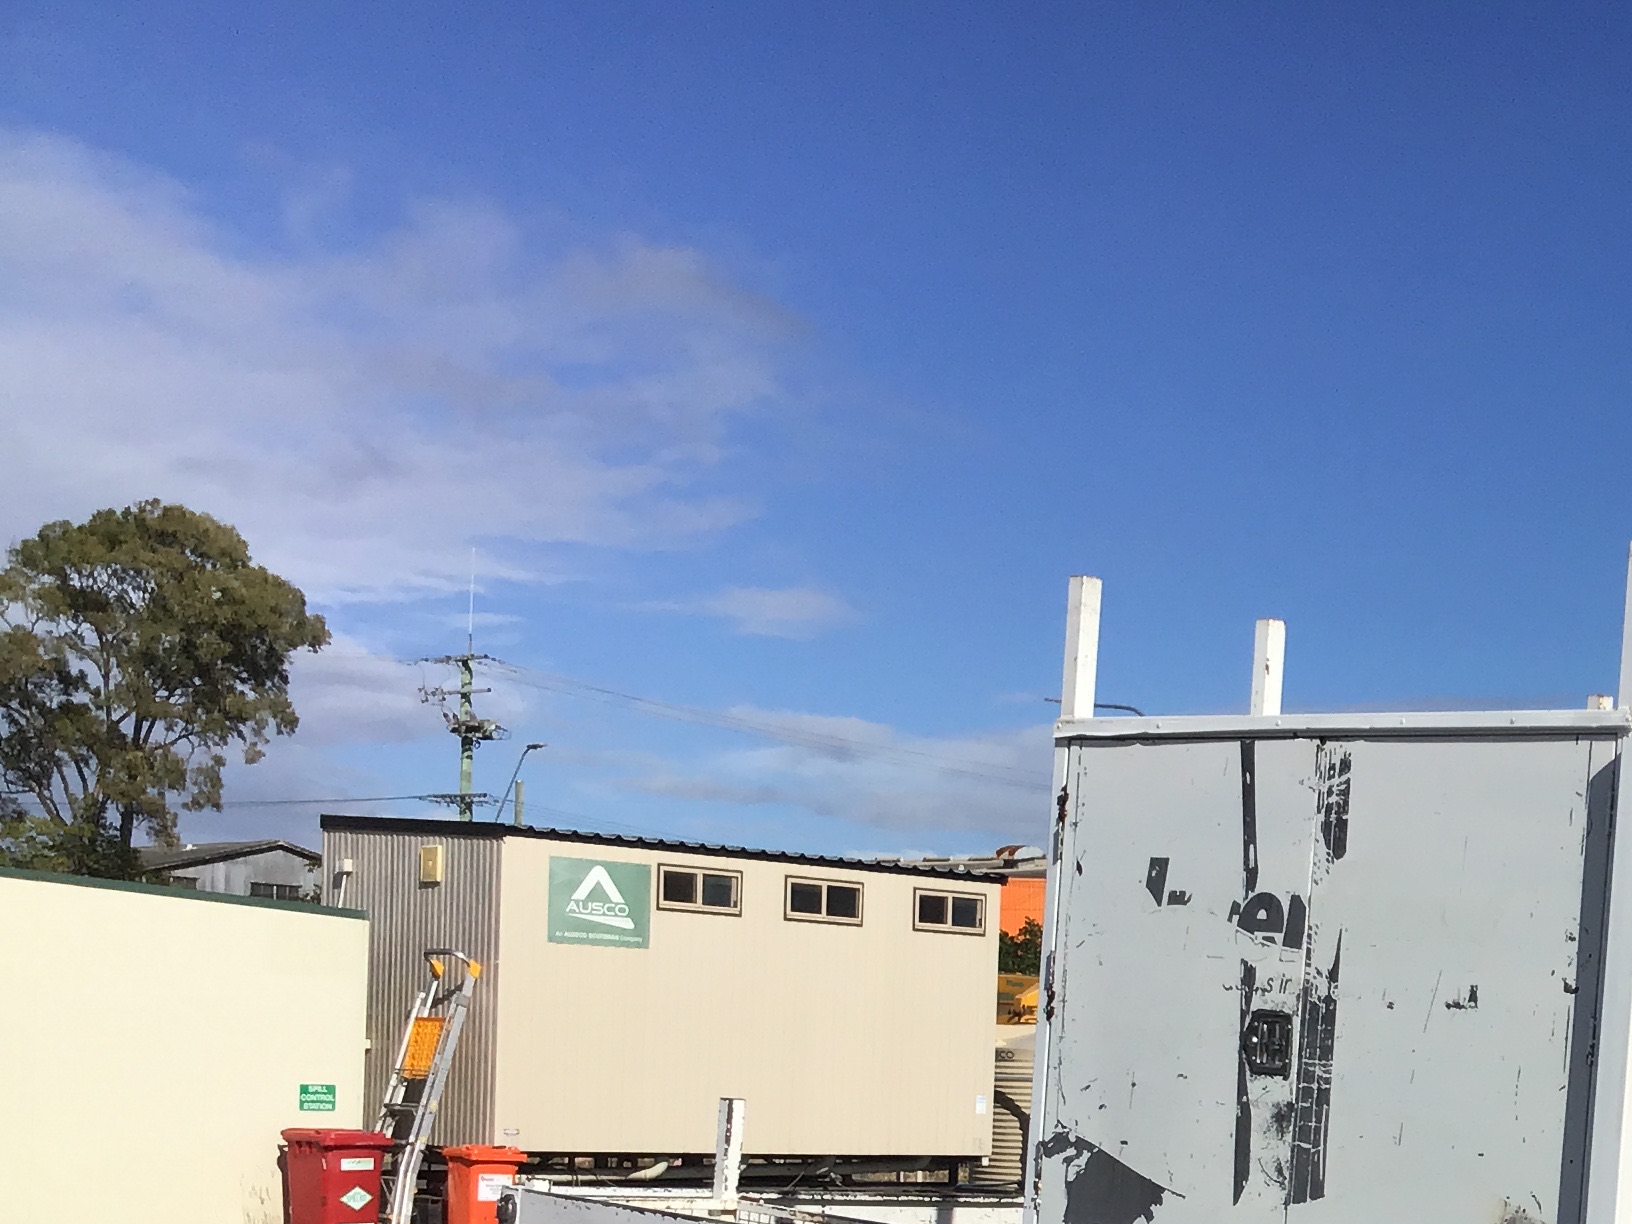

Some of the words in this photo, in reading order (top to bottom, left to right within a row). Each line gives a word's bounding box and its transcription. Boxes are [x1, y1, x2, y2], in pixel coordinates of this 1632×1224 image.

[566, 900, 630, 917] AUSCO
[308, 1085, 328, 1093] SPILL
[303, 1102, 333, 1110] STATION
